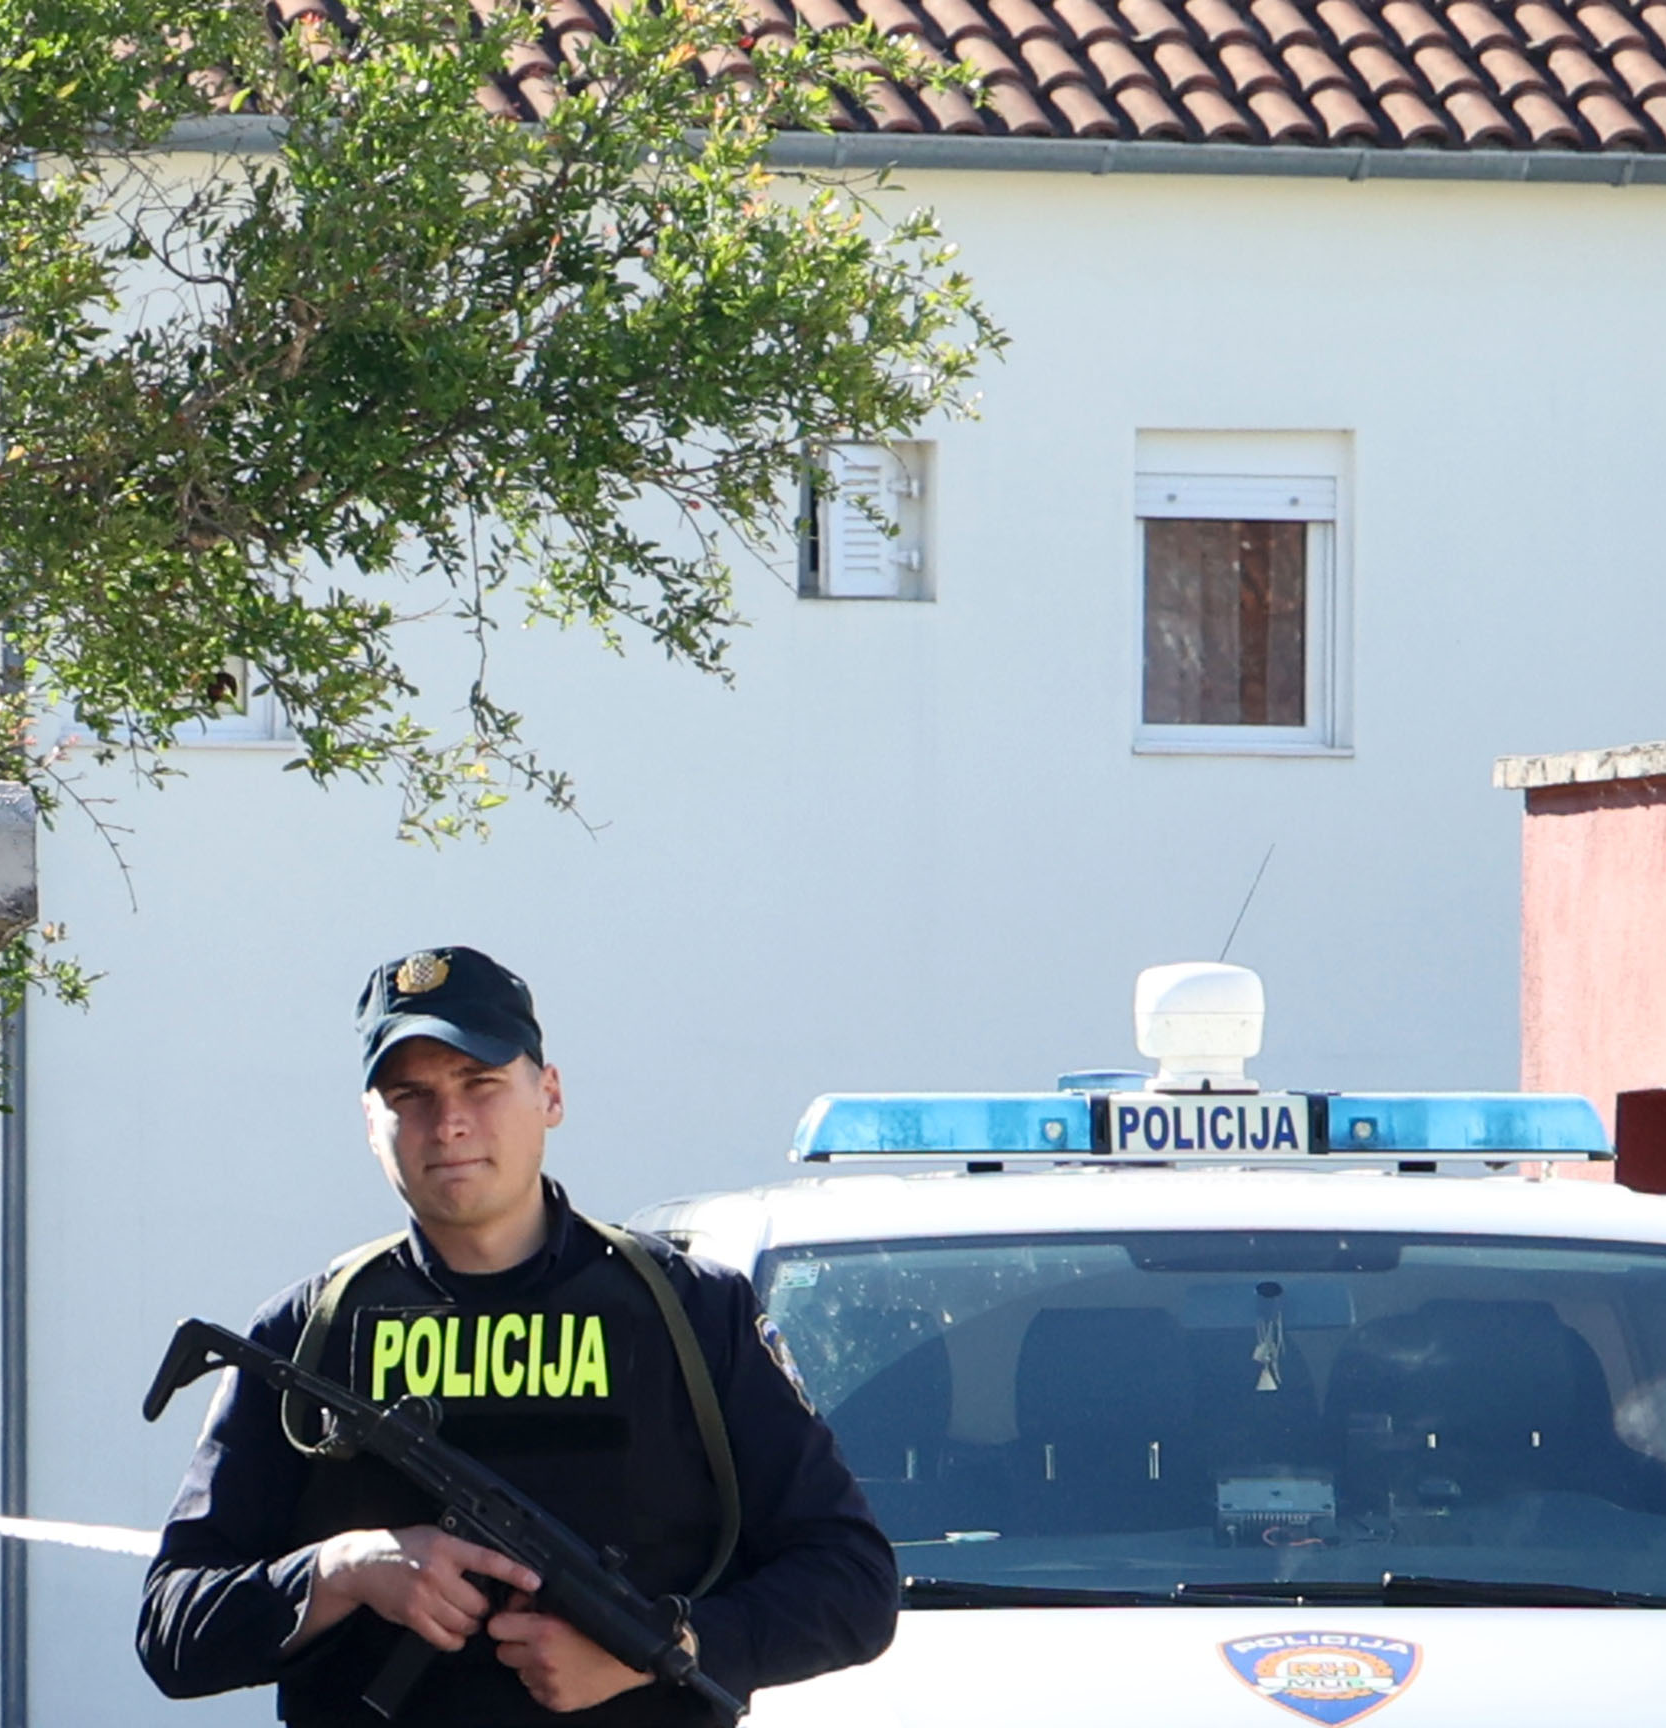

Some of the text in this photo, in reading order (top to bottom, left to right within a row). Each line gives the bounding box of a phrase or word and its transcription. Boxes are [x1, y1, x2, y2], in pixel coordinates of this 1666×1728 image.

[1118, 1105, 1299, 1151] POLICIJA
[372, 1313, 609, 1400] POLICIJA
[1231, 1634, 1409, 1655] POLICIJA
